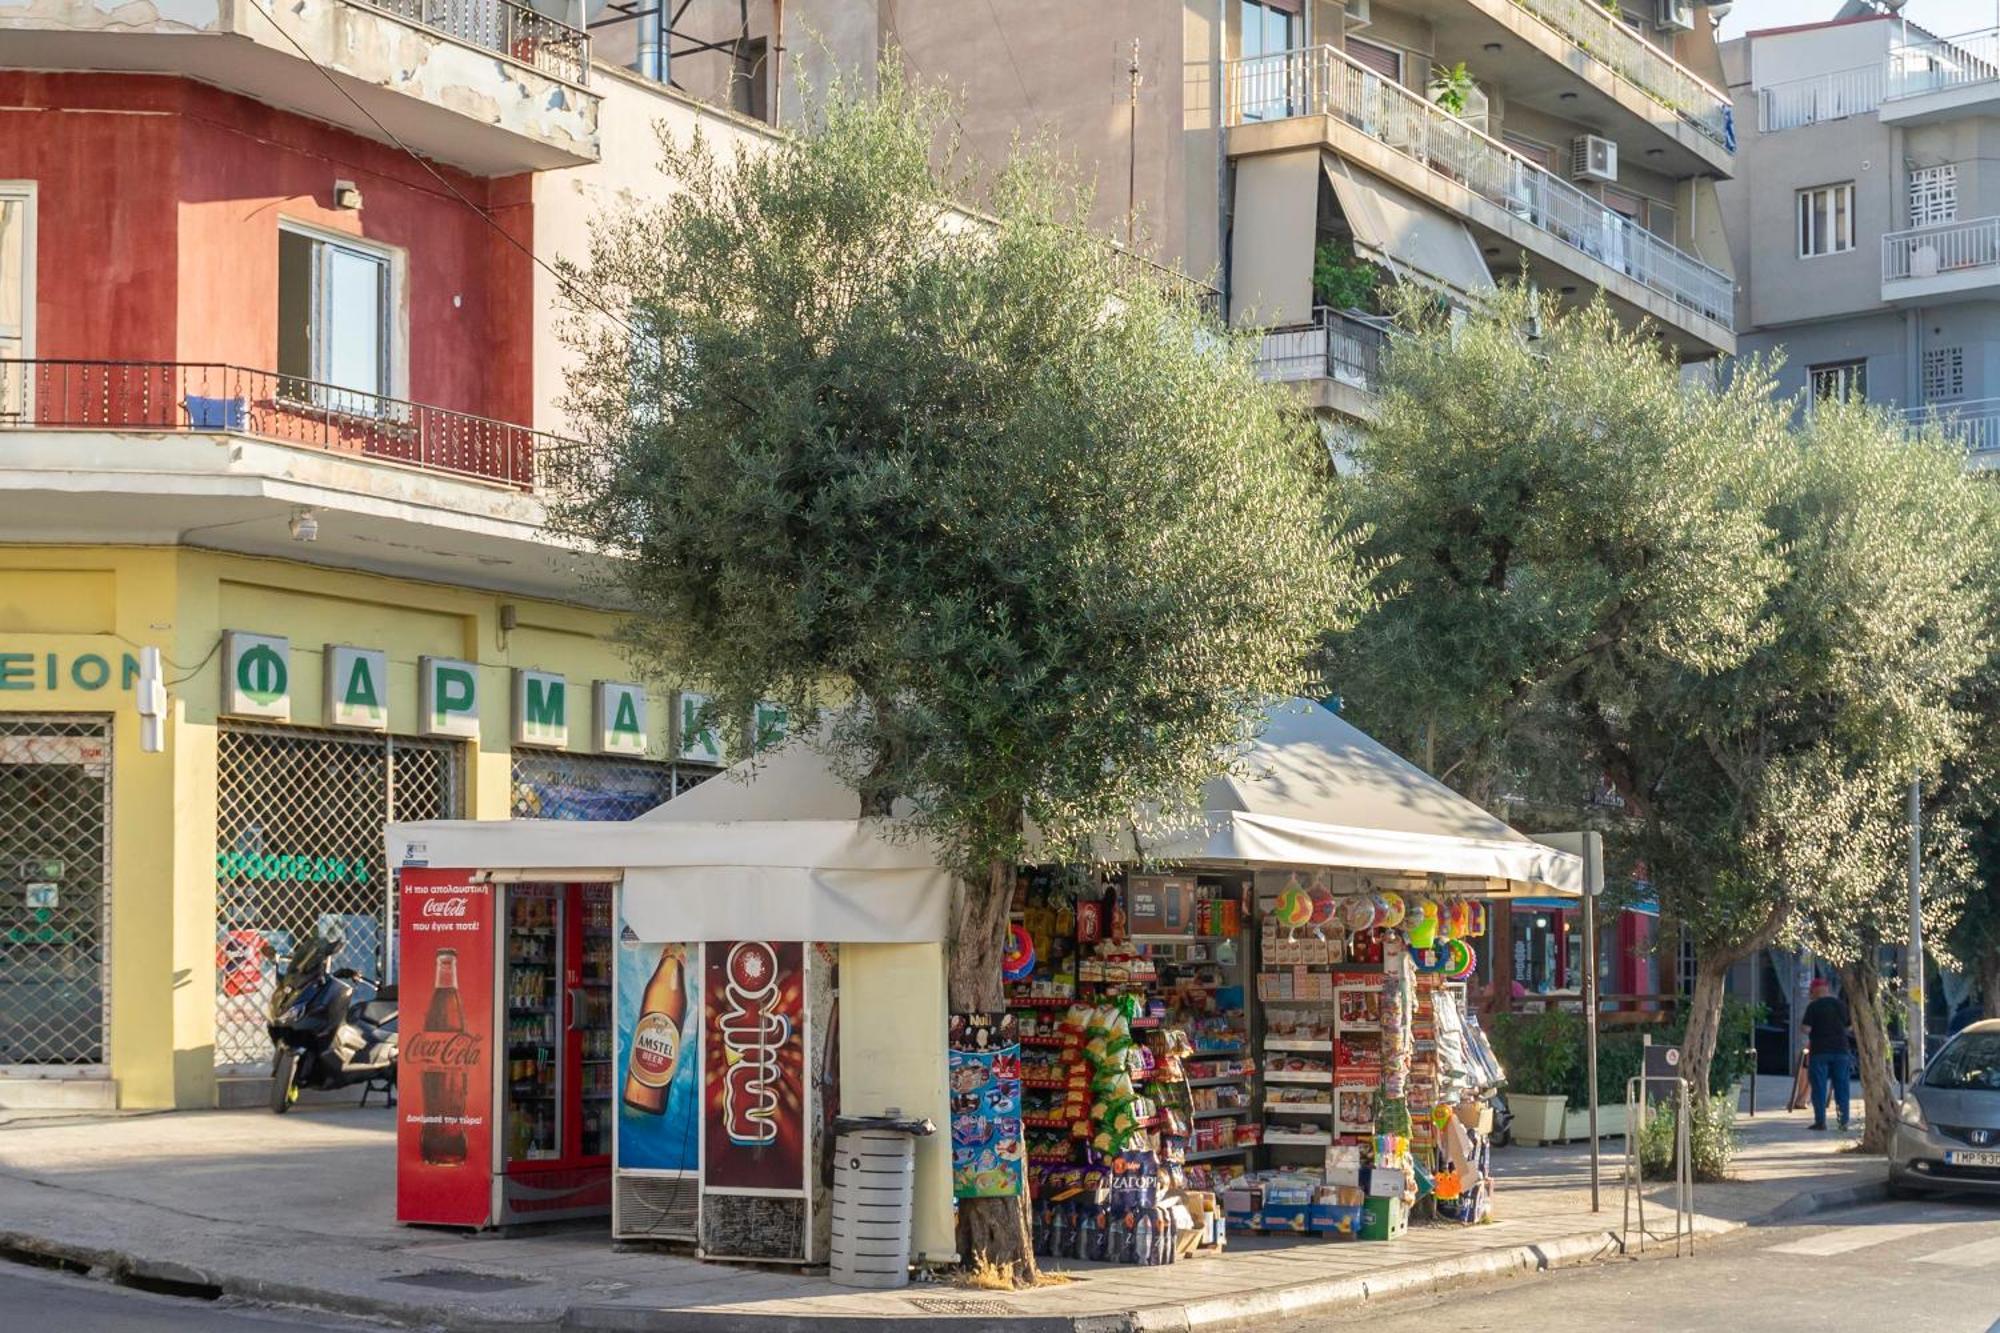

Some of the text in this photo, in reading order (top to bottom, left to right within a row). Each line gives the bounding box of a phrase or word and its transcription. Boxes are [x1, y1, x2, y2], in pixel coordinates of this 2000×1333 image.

[404, 885, 413, 894] Η
[414, 885, 429, 894] πιο
[412, 922, 430, 931] που
[639, 1034, 673, 1057] AMSTEL
[642, 1051, 664, 1065] BEER
